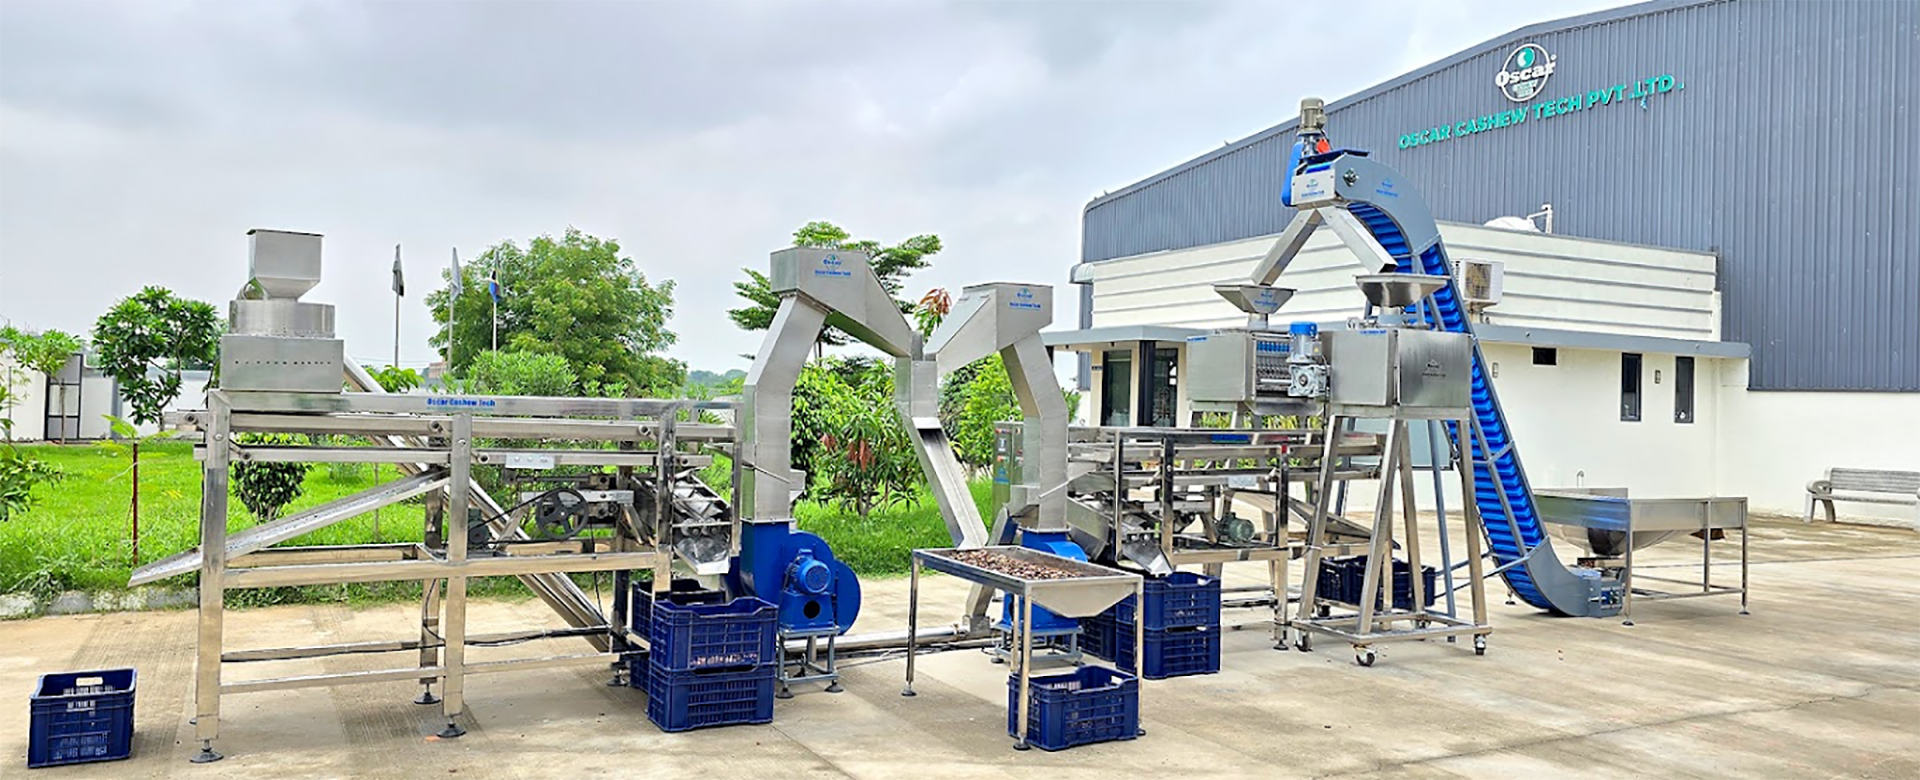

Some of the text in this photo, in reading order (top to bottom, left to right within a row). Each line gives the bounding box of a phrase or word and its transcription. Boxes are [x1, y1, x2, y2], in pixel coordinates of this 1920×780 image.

[1495, 61, 1556, 87] Oscar
[1397, 124, 1451, 150] OSCAR
[1453, 106, 1529, 137] CASHEW
[1532, 94, 1582, 119] TECH
[1586, 84, 1627, 108] PVT
